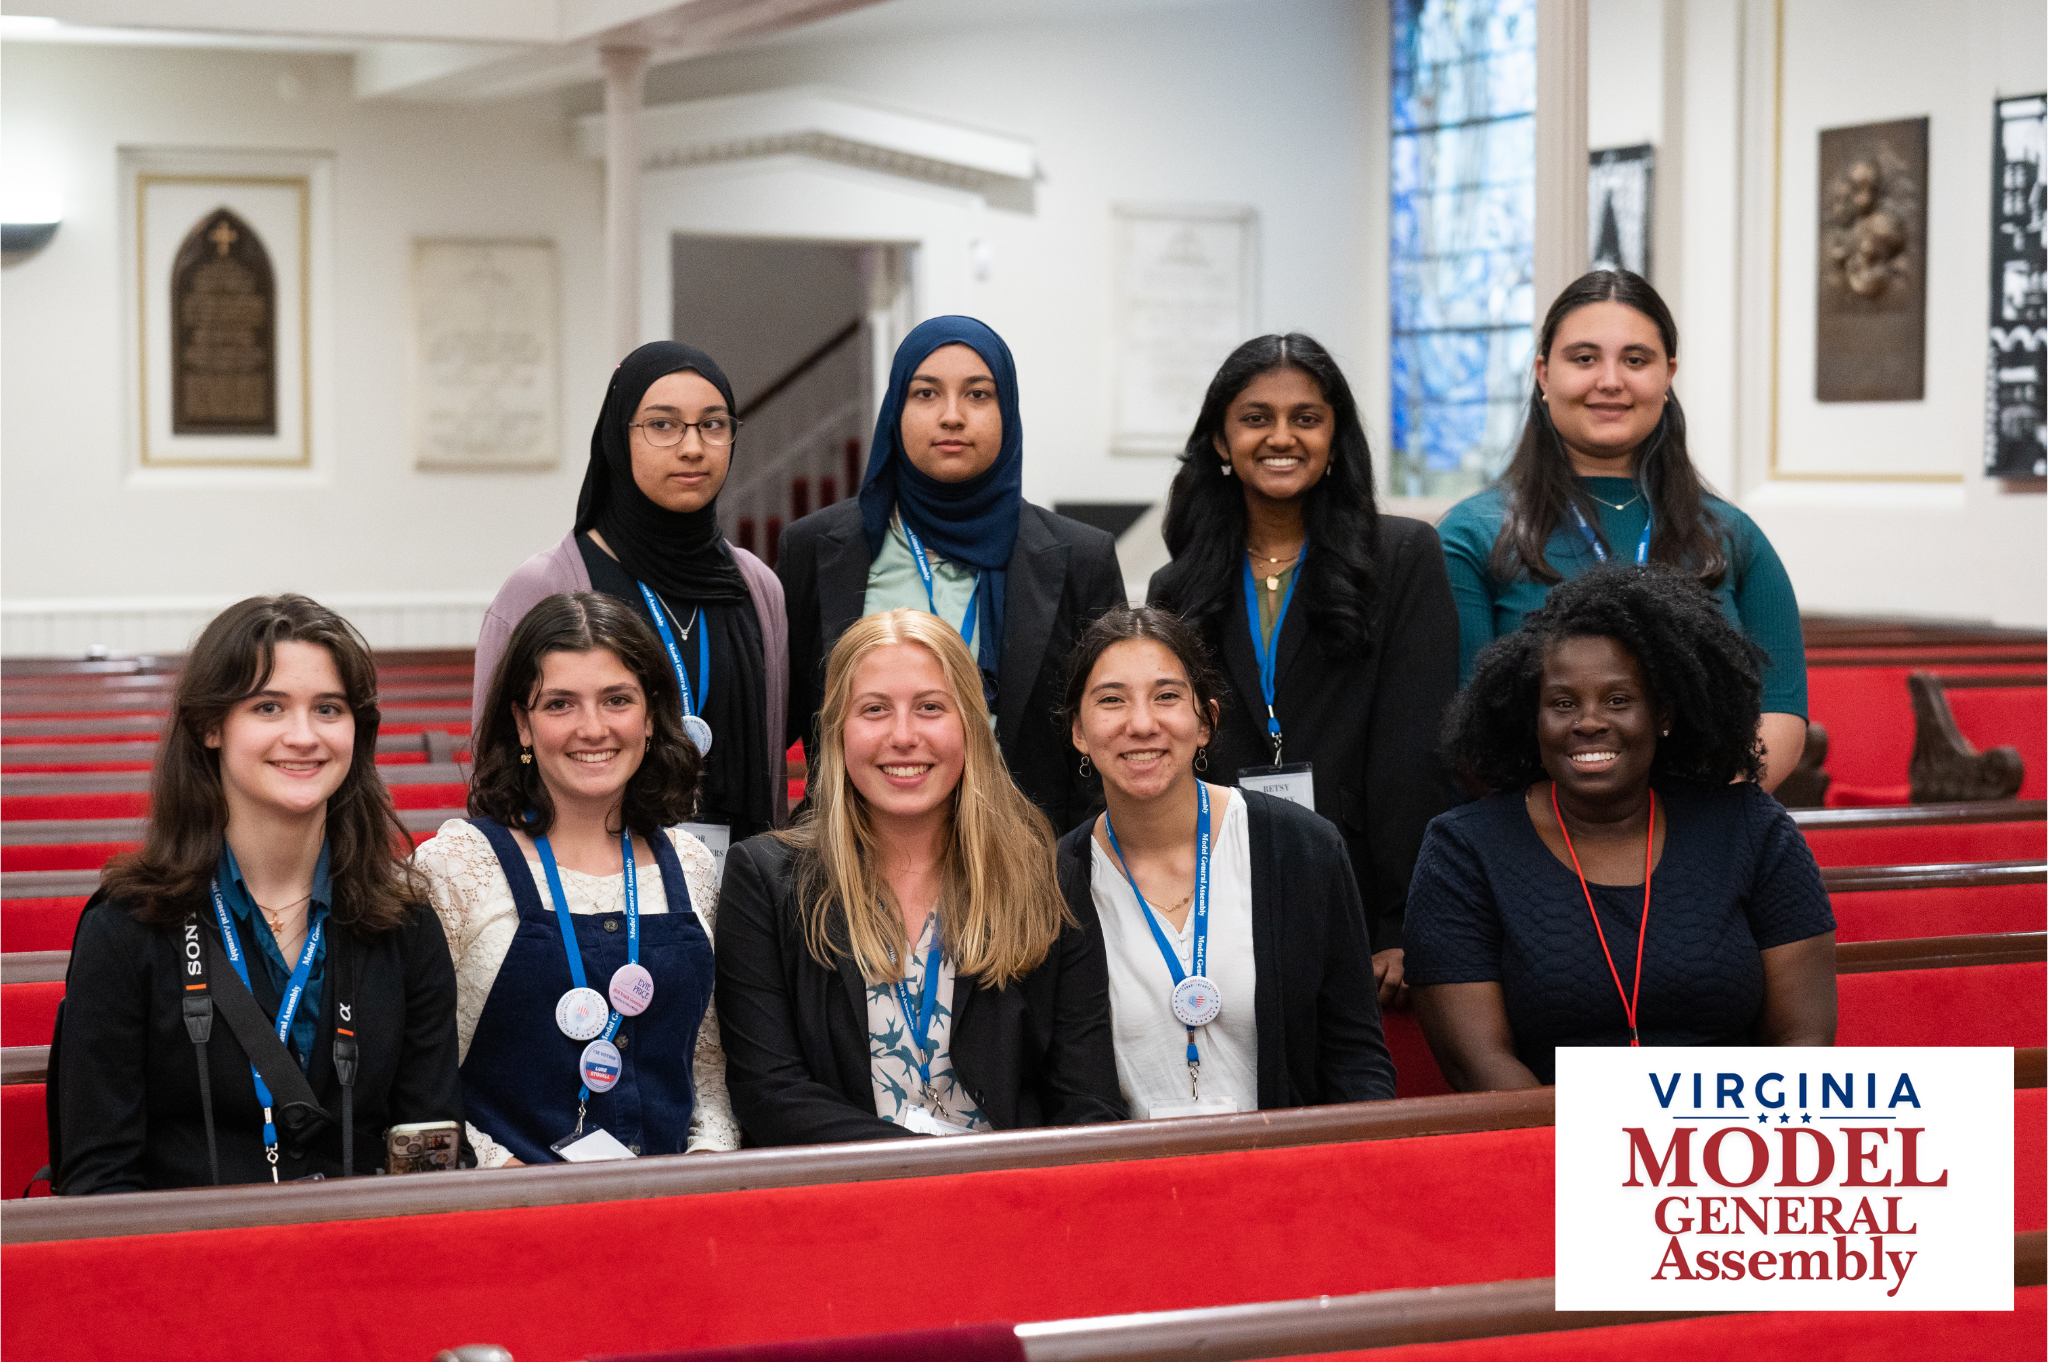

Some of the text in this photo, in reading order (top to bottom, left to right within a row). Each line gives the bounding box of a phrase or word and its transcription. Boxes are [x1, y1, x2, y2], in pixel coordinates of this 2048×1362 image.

[668, 642, 680, 664] Model
[676, 664, 688, 690] General
[1263, 784, 1289, 792] BETSY
[1200, 856, 1208, 884] General
[1198, 884, 1206, 917] Assembly
[214, 894, 230, 925] General
[223, 926, 240, 962] Assembly
[302, 942, 316, 966] Model
[1196, 936, 1205, 958] Model
[283, 984, 302, 1022] Assembly
